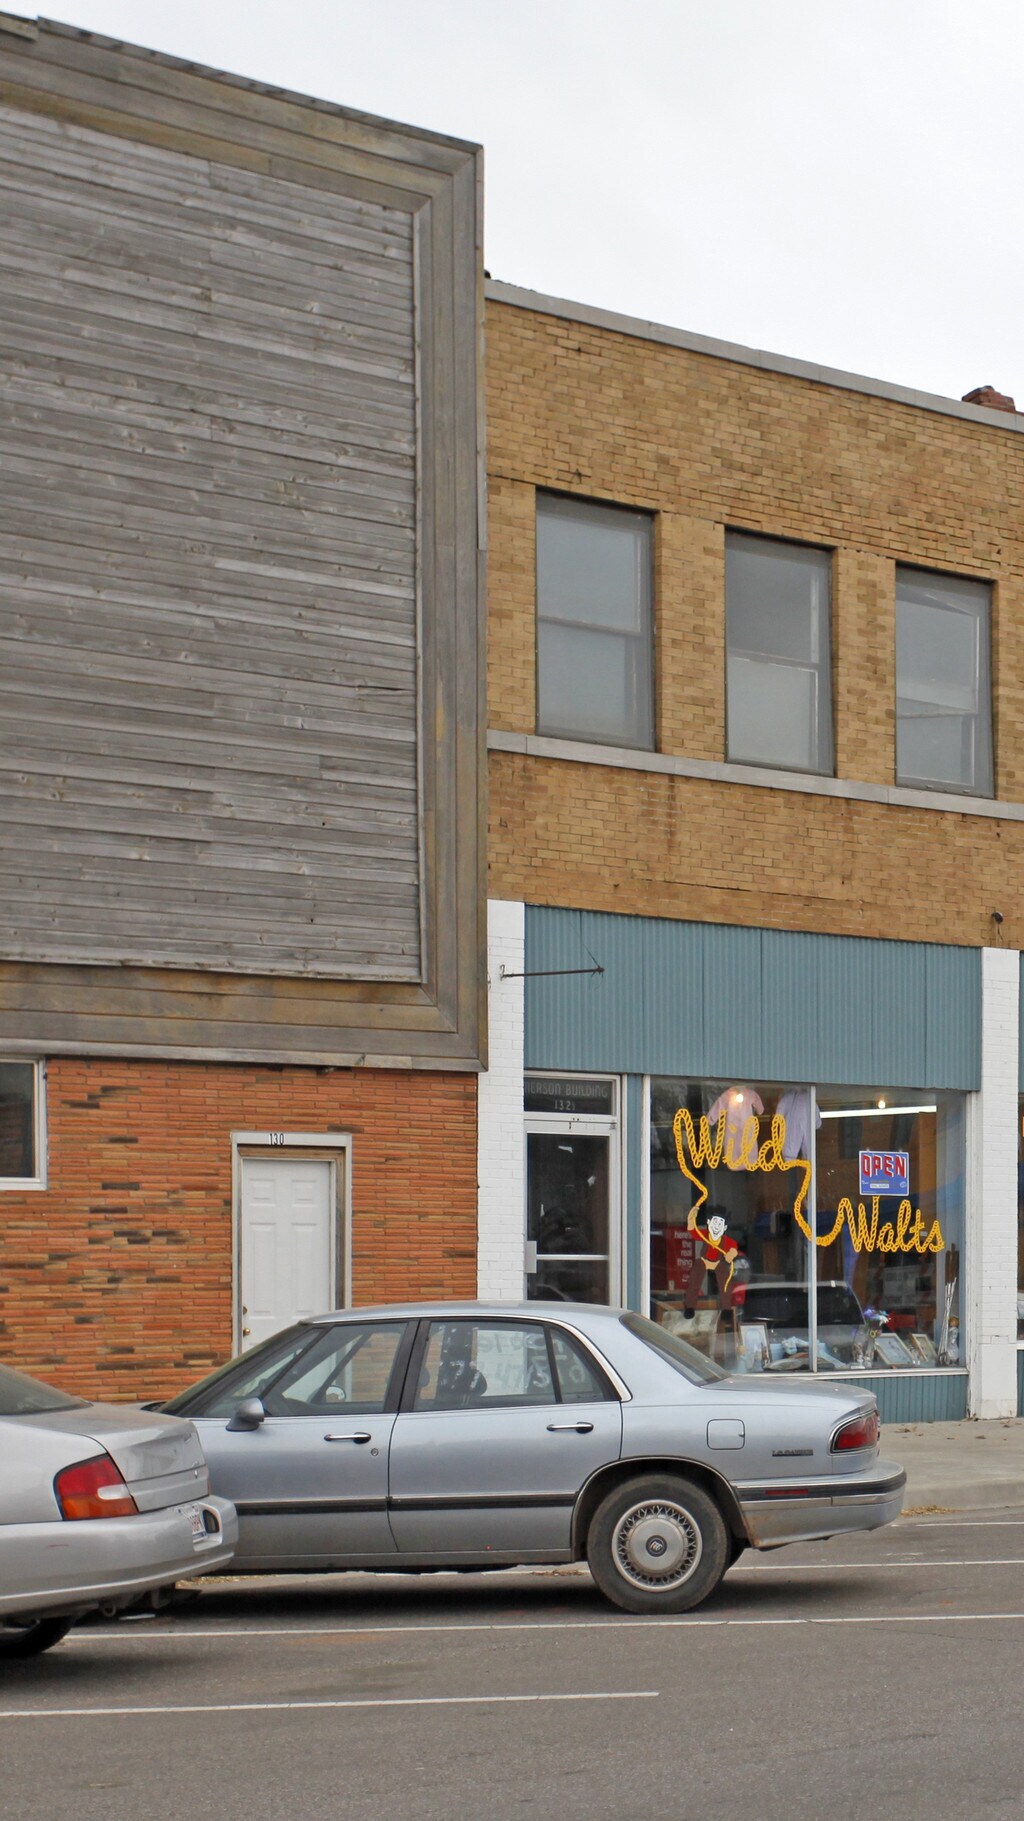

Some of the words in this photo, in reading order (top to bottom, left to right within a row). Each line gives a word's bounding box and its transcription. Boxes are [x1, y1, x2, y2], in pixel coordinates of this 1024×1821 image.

[565, 1083, 608, 1098] BUILDING
[269, 1132, 285, 1146] 130
[673, 1108, 789, 1172] Wild
[862, 1153, 907, 1179] OPEN
